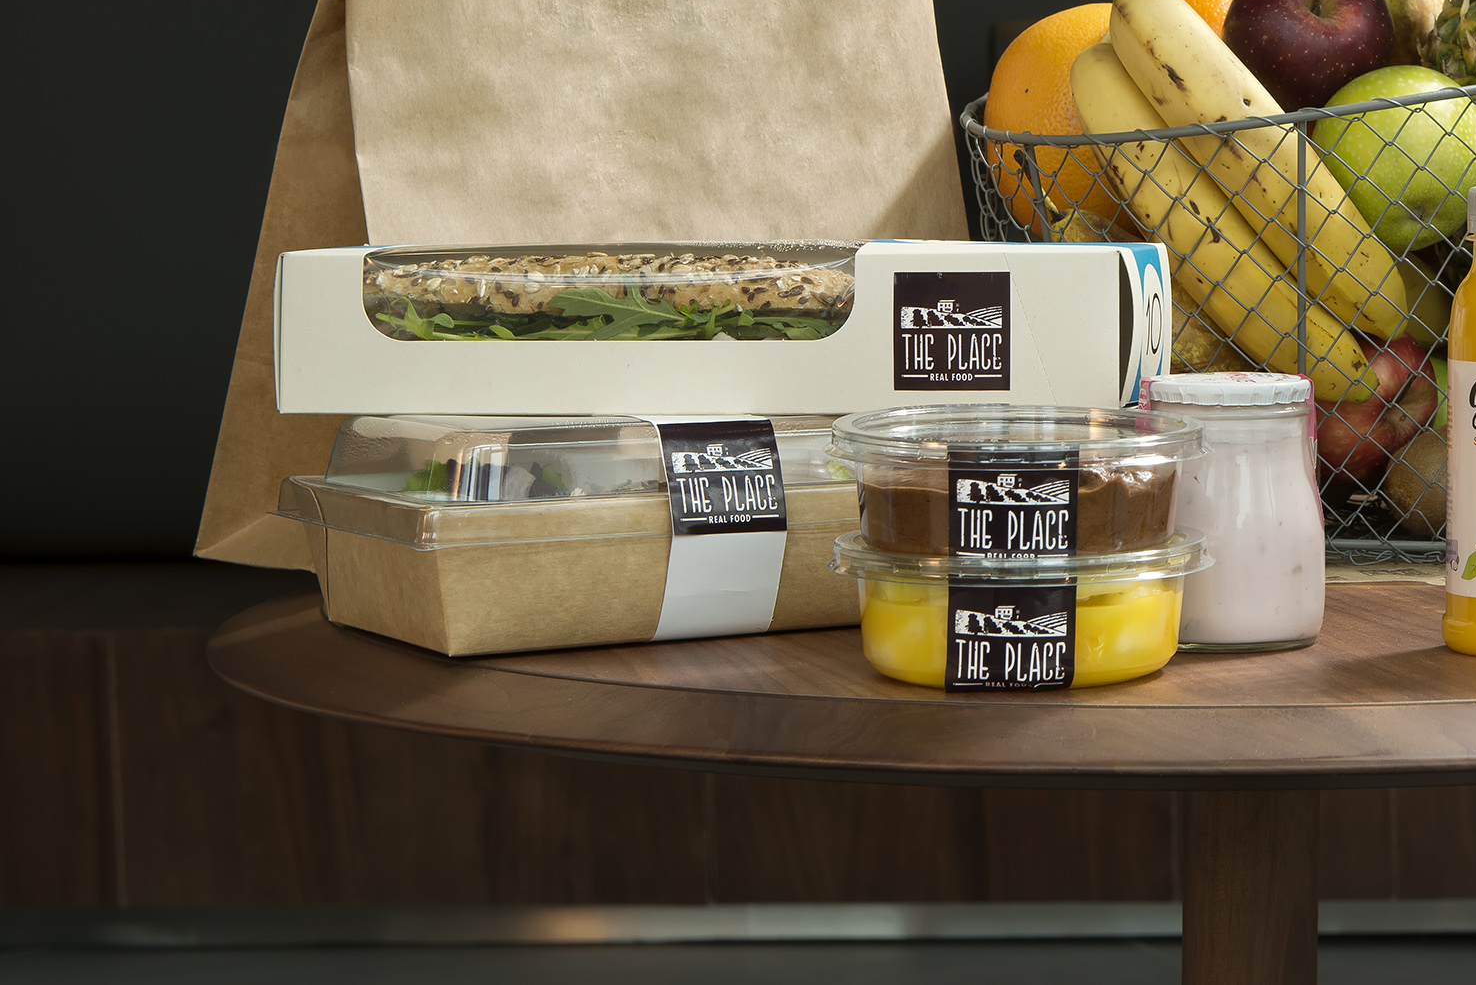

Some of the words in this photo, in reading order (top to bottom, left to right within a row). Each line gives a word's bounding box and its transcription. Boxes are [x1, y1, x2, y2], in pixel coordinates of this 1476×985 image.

[901, 333, 935, 371] THE
[947, 333, 1003, 371] PLACE
[929, 373, 949, 382] REAL
[951, 373, 974, 382] FOOD
[675, 476, 712, 514] THE
[721, 474, 778, 512] PLACE
[708, 515, 728, 524] REAL
[729, 514, 752, 523] FOOD
[957, 507, 993, 549] THE
[1007, 509, 1069, 551] PLACE
[955, 638, 991, 680] THE
[1005, 641, 1067, 682] PLACE
